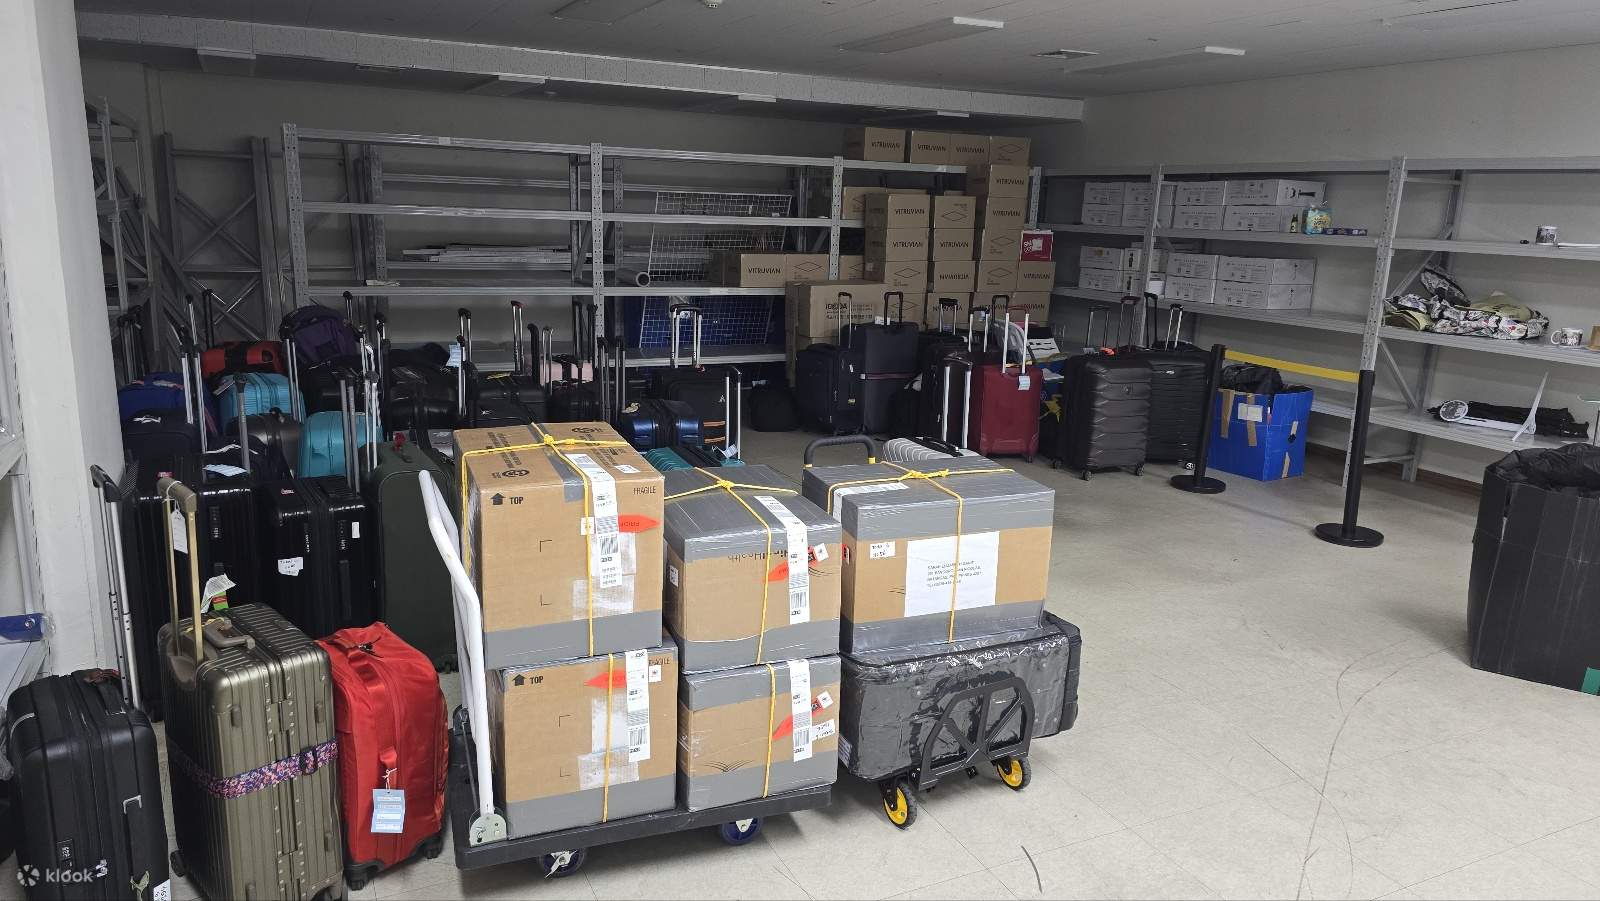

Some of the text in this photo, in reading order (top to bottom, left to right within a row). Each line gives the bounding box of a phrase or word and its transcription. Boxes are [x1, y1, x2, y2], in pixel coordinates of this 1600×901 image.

[871, 141, 900, 149] VITRUVIAN
[917, 143, 946, 151] VITRUVIAN
[992, 209, 1021, 217] VITRUVIAN
[747, 267, 781, 275] VITRUVIAN
[633, 485, 657, 494] FRAGILE
[509, 496, 524, 505] TOP
[529, 676, 544, 685] TOP
